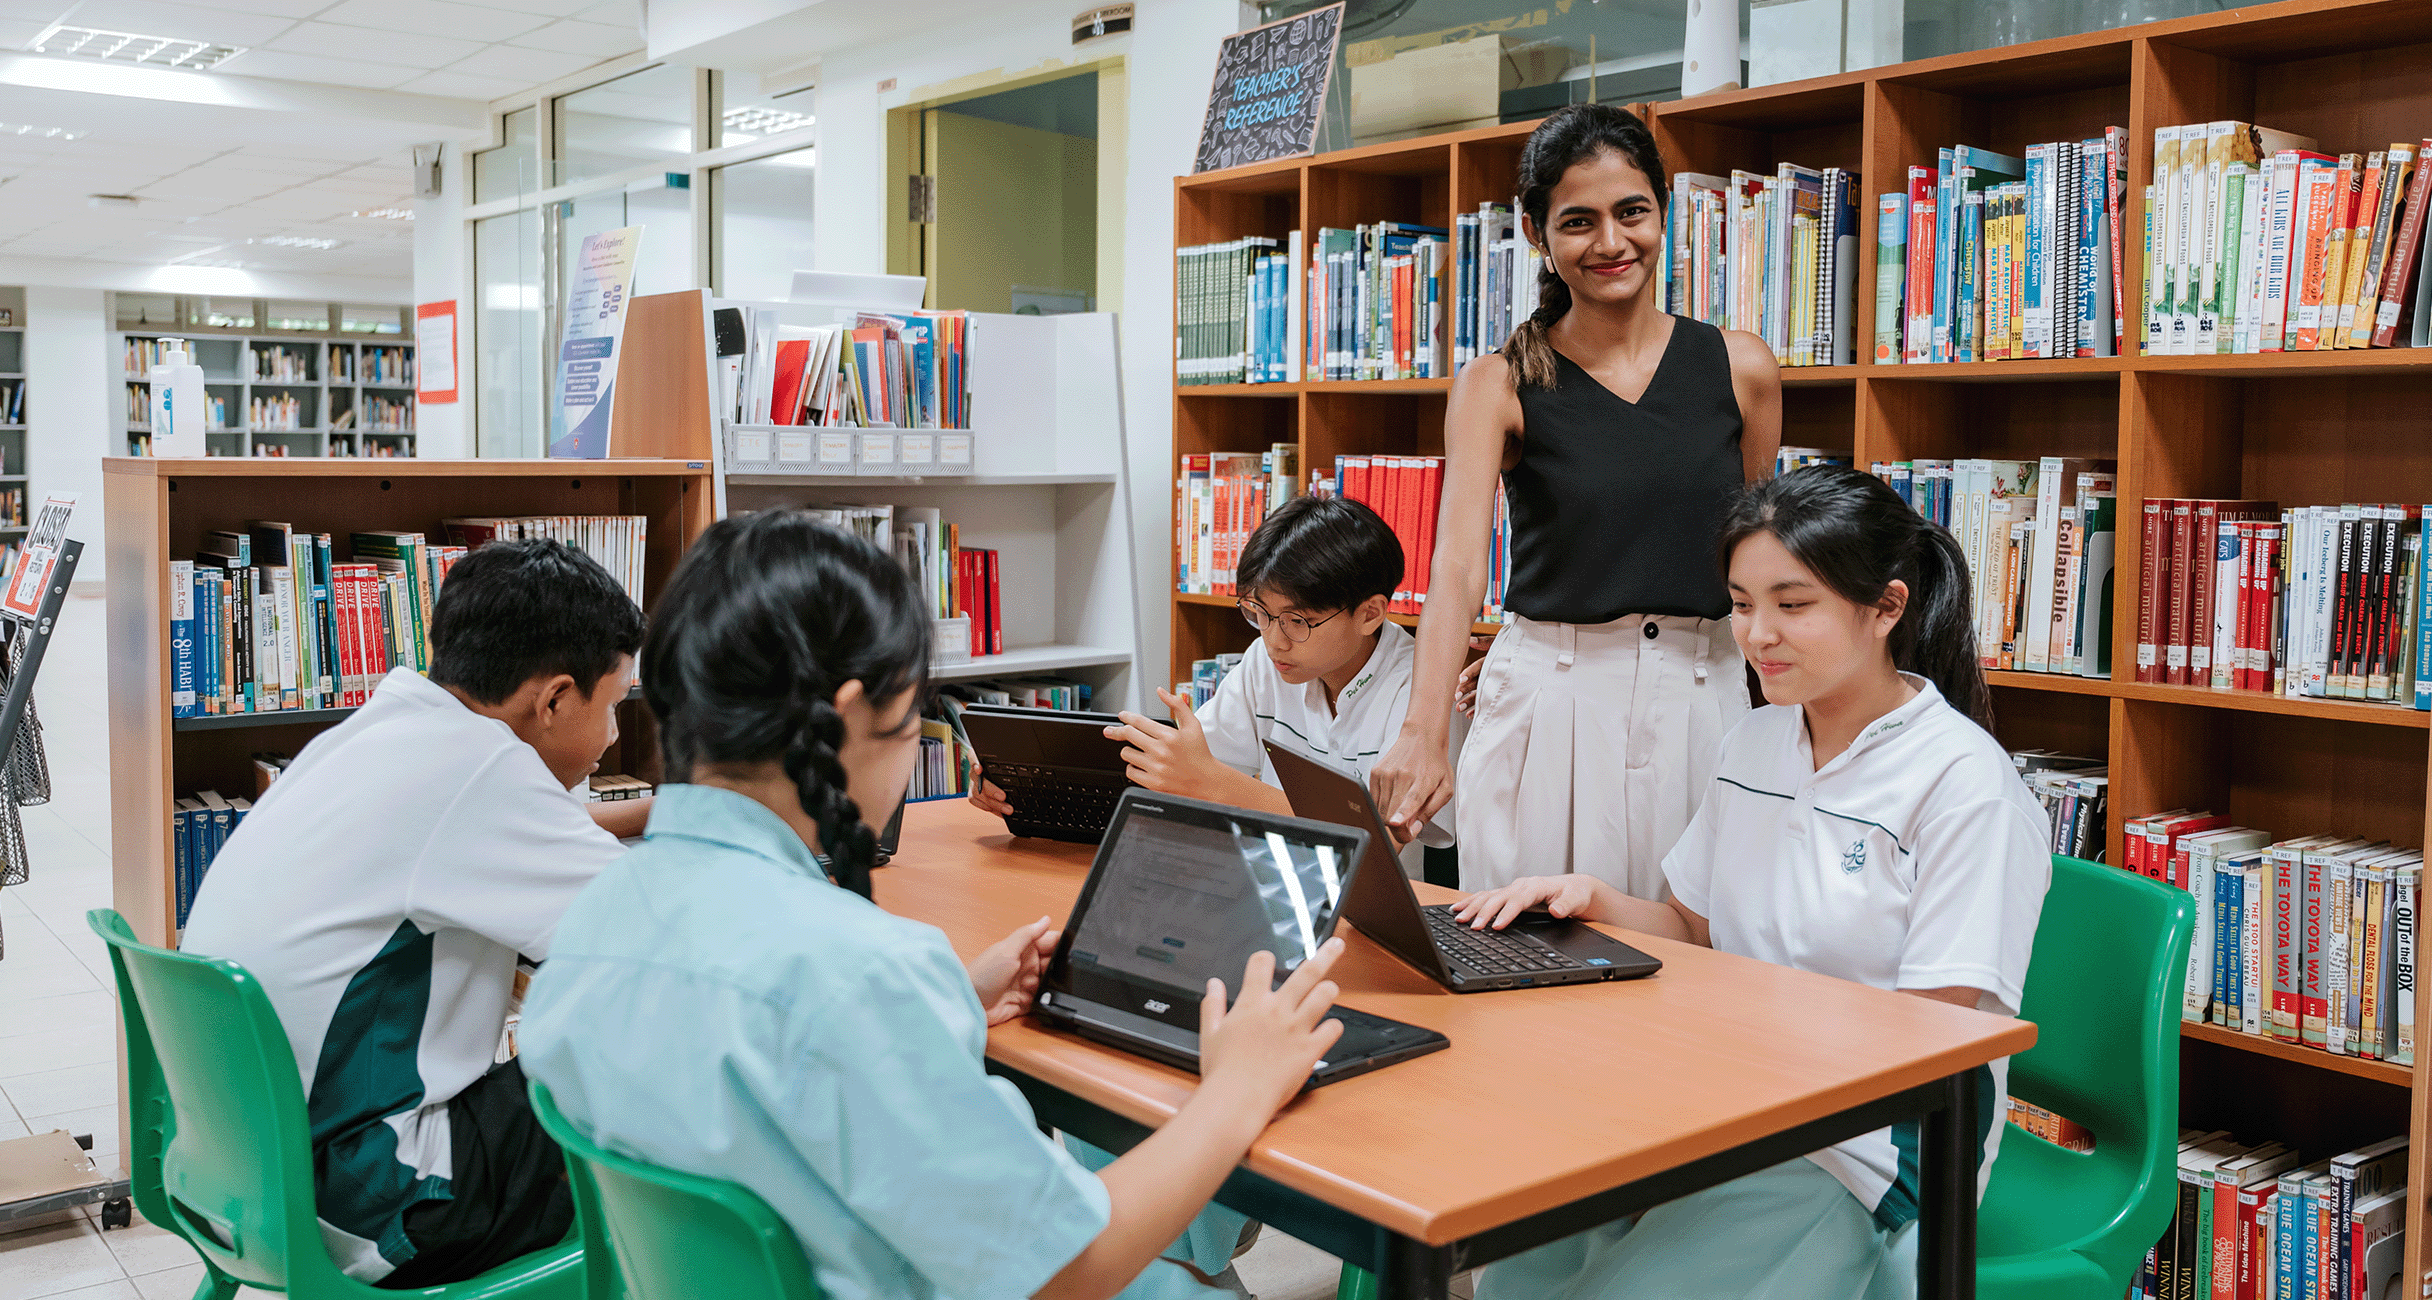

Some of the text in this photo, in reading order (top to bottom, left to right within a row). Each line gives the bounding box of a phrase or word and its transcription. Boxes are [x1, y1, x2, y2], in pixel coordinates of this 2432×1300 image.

[1233, 62, 1303, 101] TEACHER'S
[1224, 90, 1304, 131] REFERENCE
[2031, 164, 2042, 287] Physical Education for Children
[2156, 203, 2164, 240] ENCYCLOPEDIA
[2181, 203, 2189, 239] ENCYCLOPEDIA
[2207, 201, 2215, 238] ENCYCLOPEDIA
[2268, 190, 2289, 299] ALL KIDS ARE OUR KIDS
[2313, 238, 2321, 284] BRINGING
[2077, 246, 2090, 321] CHEMISTRY
[2089, 245, 2098, 293] World of
[2142, 295, 2150, 327] Cooper
[2143, 540, 2152, 594] artificial
[2173, 541, 2183, 592] artificial
[2220, 540, 2228, 558] CATS
[2240, 538, 2249, 588] MANAGING UP
[2259, 540, 2269, 591] MANAGING UP
[2341, 522, 2352, 572] EXECUTION
[2360, 523, 2373, 573] EXECUTION
[2383, 523, 2396, 574] EXECUTION
[2053, 520, 2073, 623] Collapsible
[2197, 542, 2207, 593] artificial
[2254, 579, 2260, 590] UP
[2317, 529, 2330, 615] Our Iceberg Is Melting
[2340, 573, 2348, 597] BOSSIDY
[2359, 574, 2368, 598] BOSSIDY
[2382, 574, 2390, 599] BOSSIDY
[279, 580, 291, 662] HONOR YOUR ANGER
[2067, 603, 2075, 638] PRODUCTS
[173, 638, 192, 659] 8th
[2078, 803, 2088, 839] Physical
[2251, 923, 2259, 945] $100
[2277, 861, 2291, 988] THE TOYOTA WAY
[2307, 865, 2321, 993] THE TOYOTA WAY
[2397, 885, 2413, 993] agel OUT of the BOX
[2189, 958, 2197, 982] Robert
[2363, 923, 2376, 1018] DENTAL FLOSS FOR THE MIND
[1144, 999, 1171, 1014] acer
[2201, 1226, 2209, 1237] big
[2281, 1198, 2292, 1229] BLUE
[2306, 1202, 2317, 1233] BLUE
[2342, 1211, 2350, 1233] GAMES
[2242, 1221, 2250, 1252] Machine
[2280, 1232, 2292, 1273] OCEAN
[2305, 1236, 2317, 1276] OCEAN
[2320, 1250, 2328, 1262] big
[2329, 1185, 2339, 1292] EXTRA TRAINING GAMES
[2226, 1241, 2234, 1292] CULTIVATING
[2320, 1263, 2328, 1284] book
